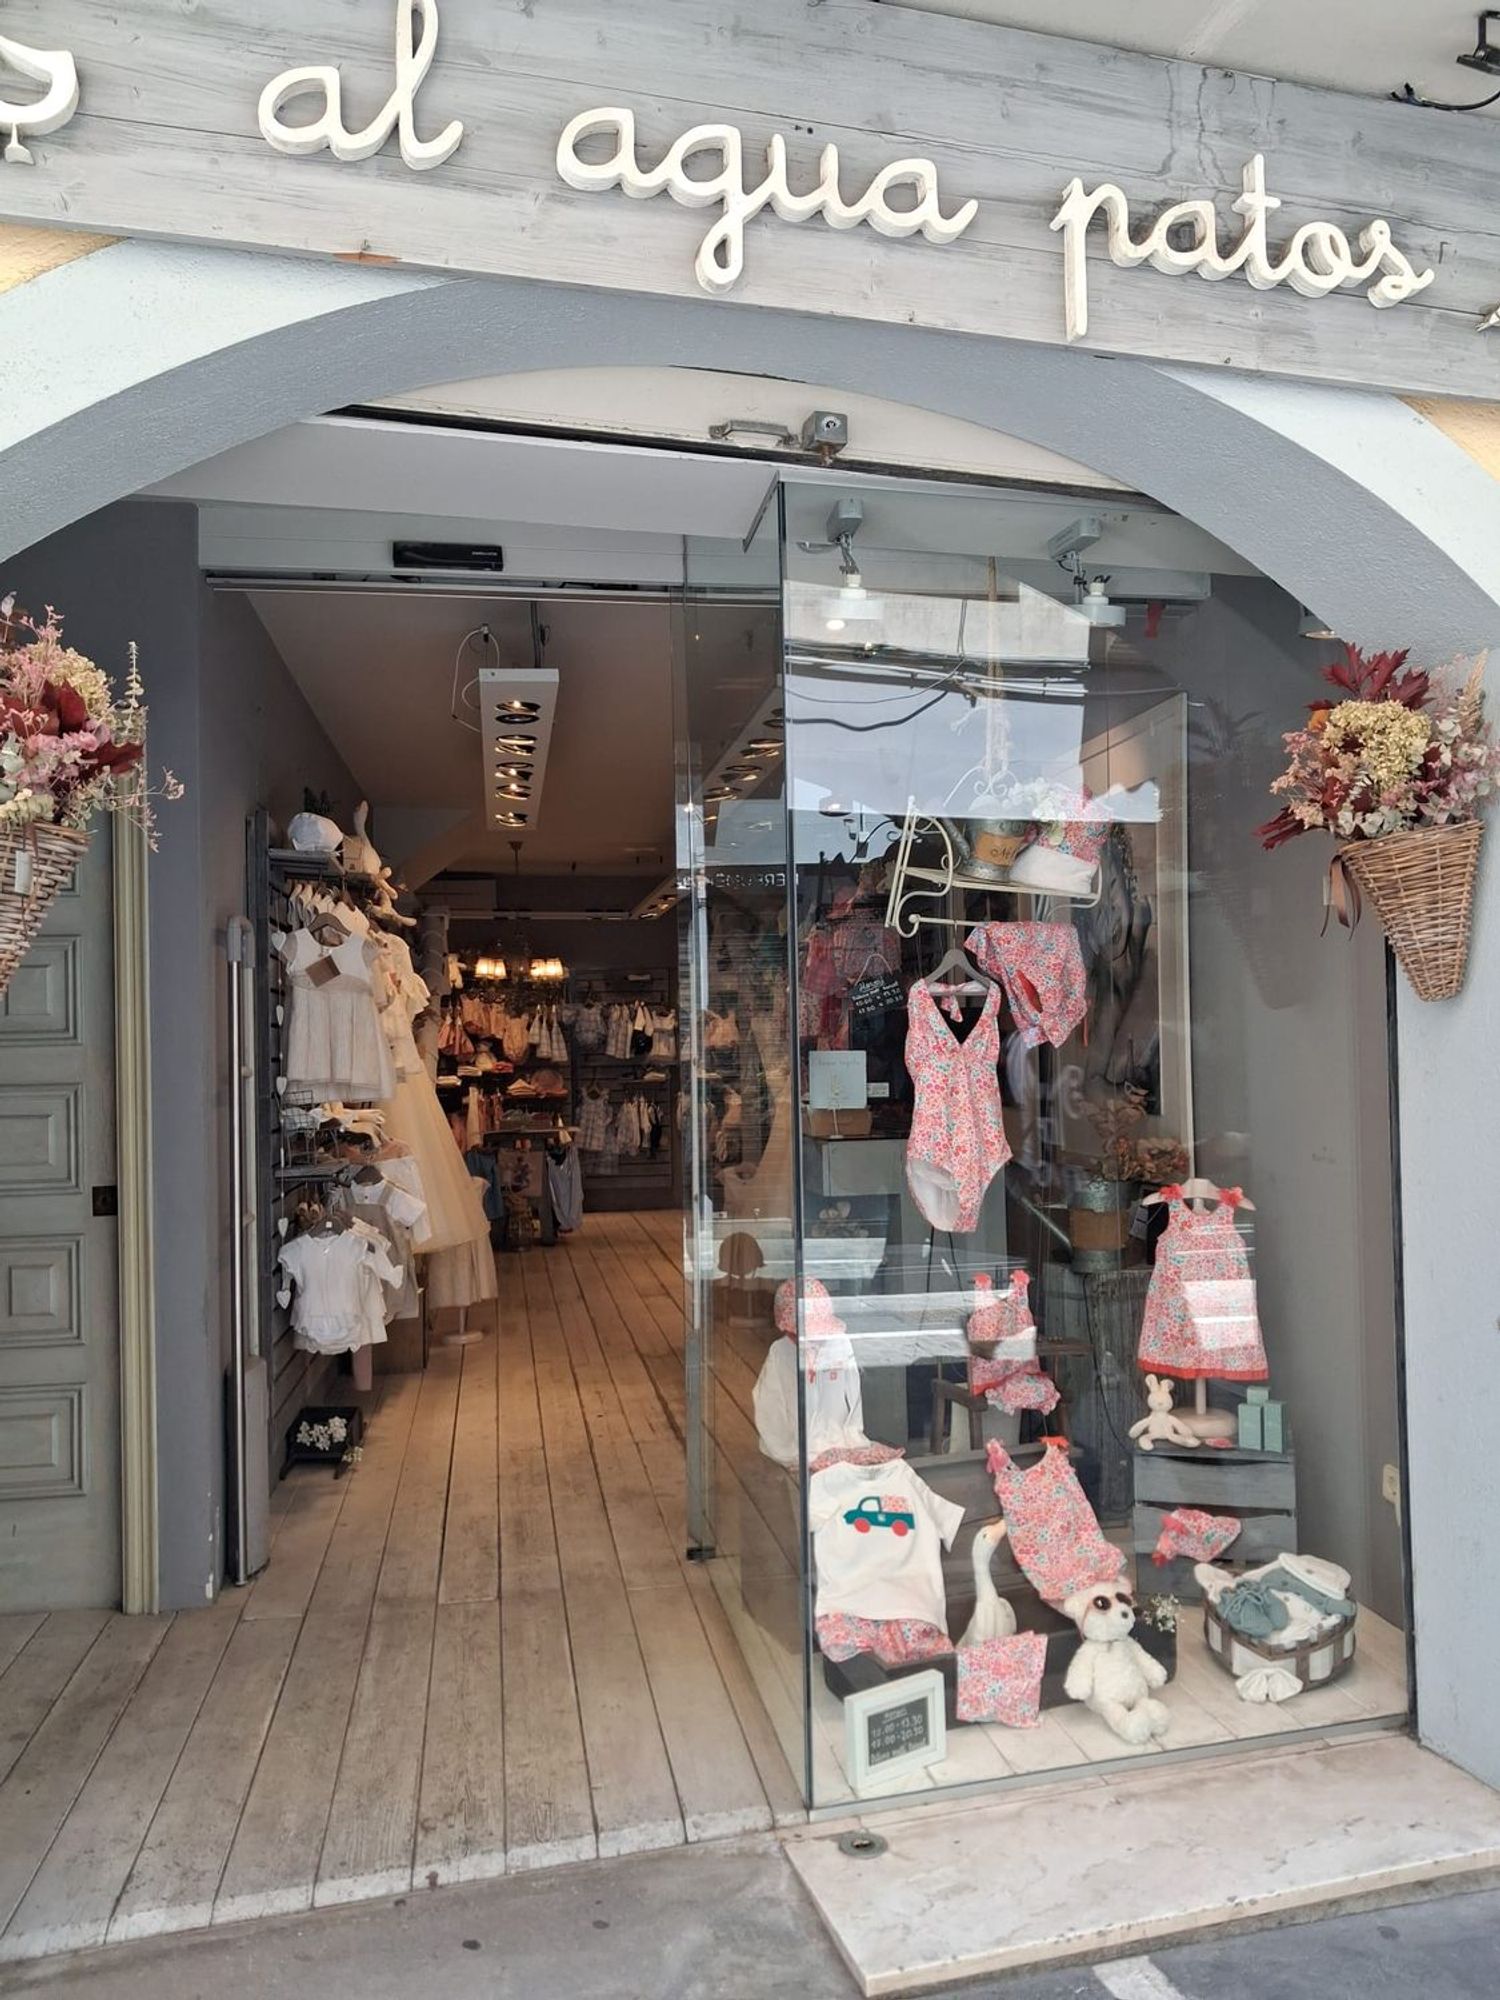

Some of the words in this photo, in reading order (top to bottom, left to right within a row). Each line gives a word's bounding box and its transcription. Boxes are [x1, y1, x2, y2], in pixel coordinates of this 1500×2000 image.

[258, 0, 463, 170] al
[556, 107, 978, 294] agua
[1049, 153, 1434, 341] patos
